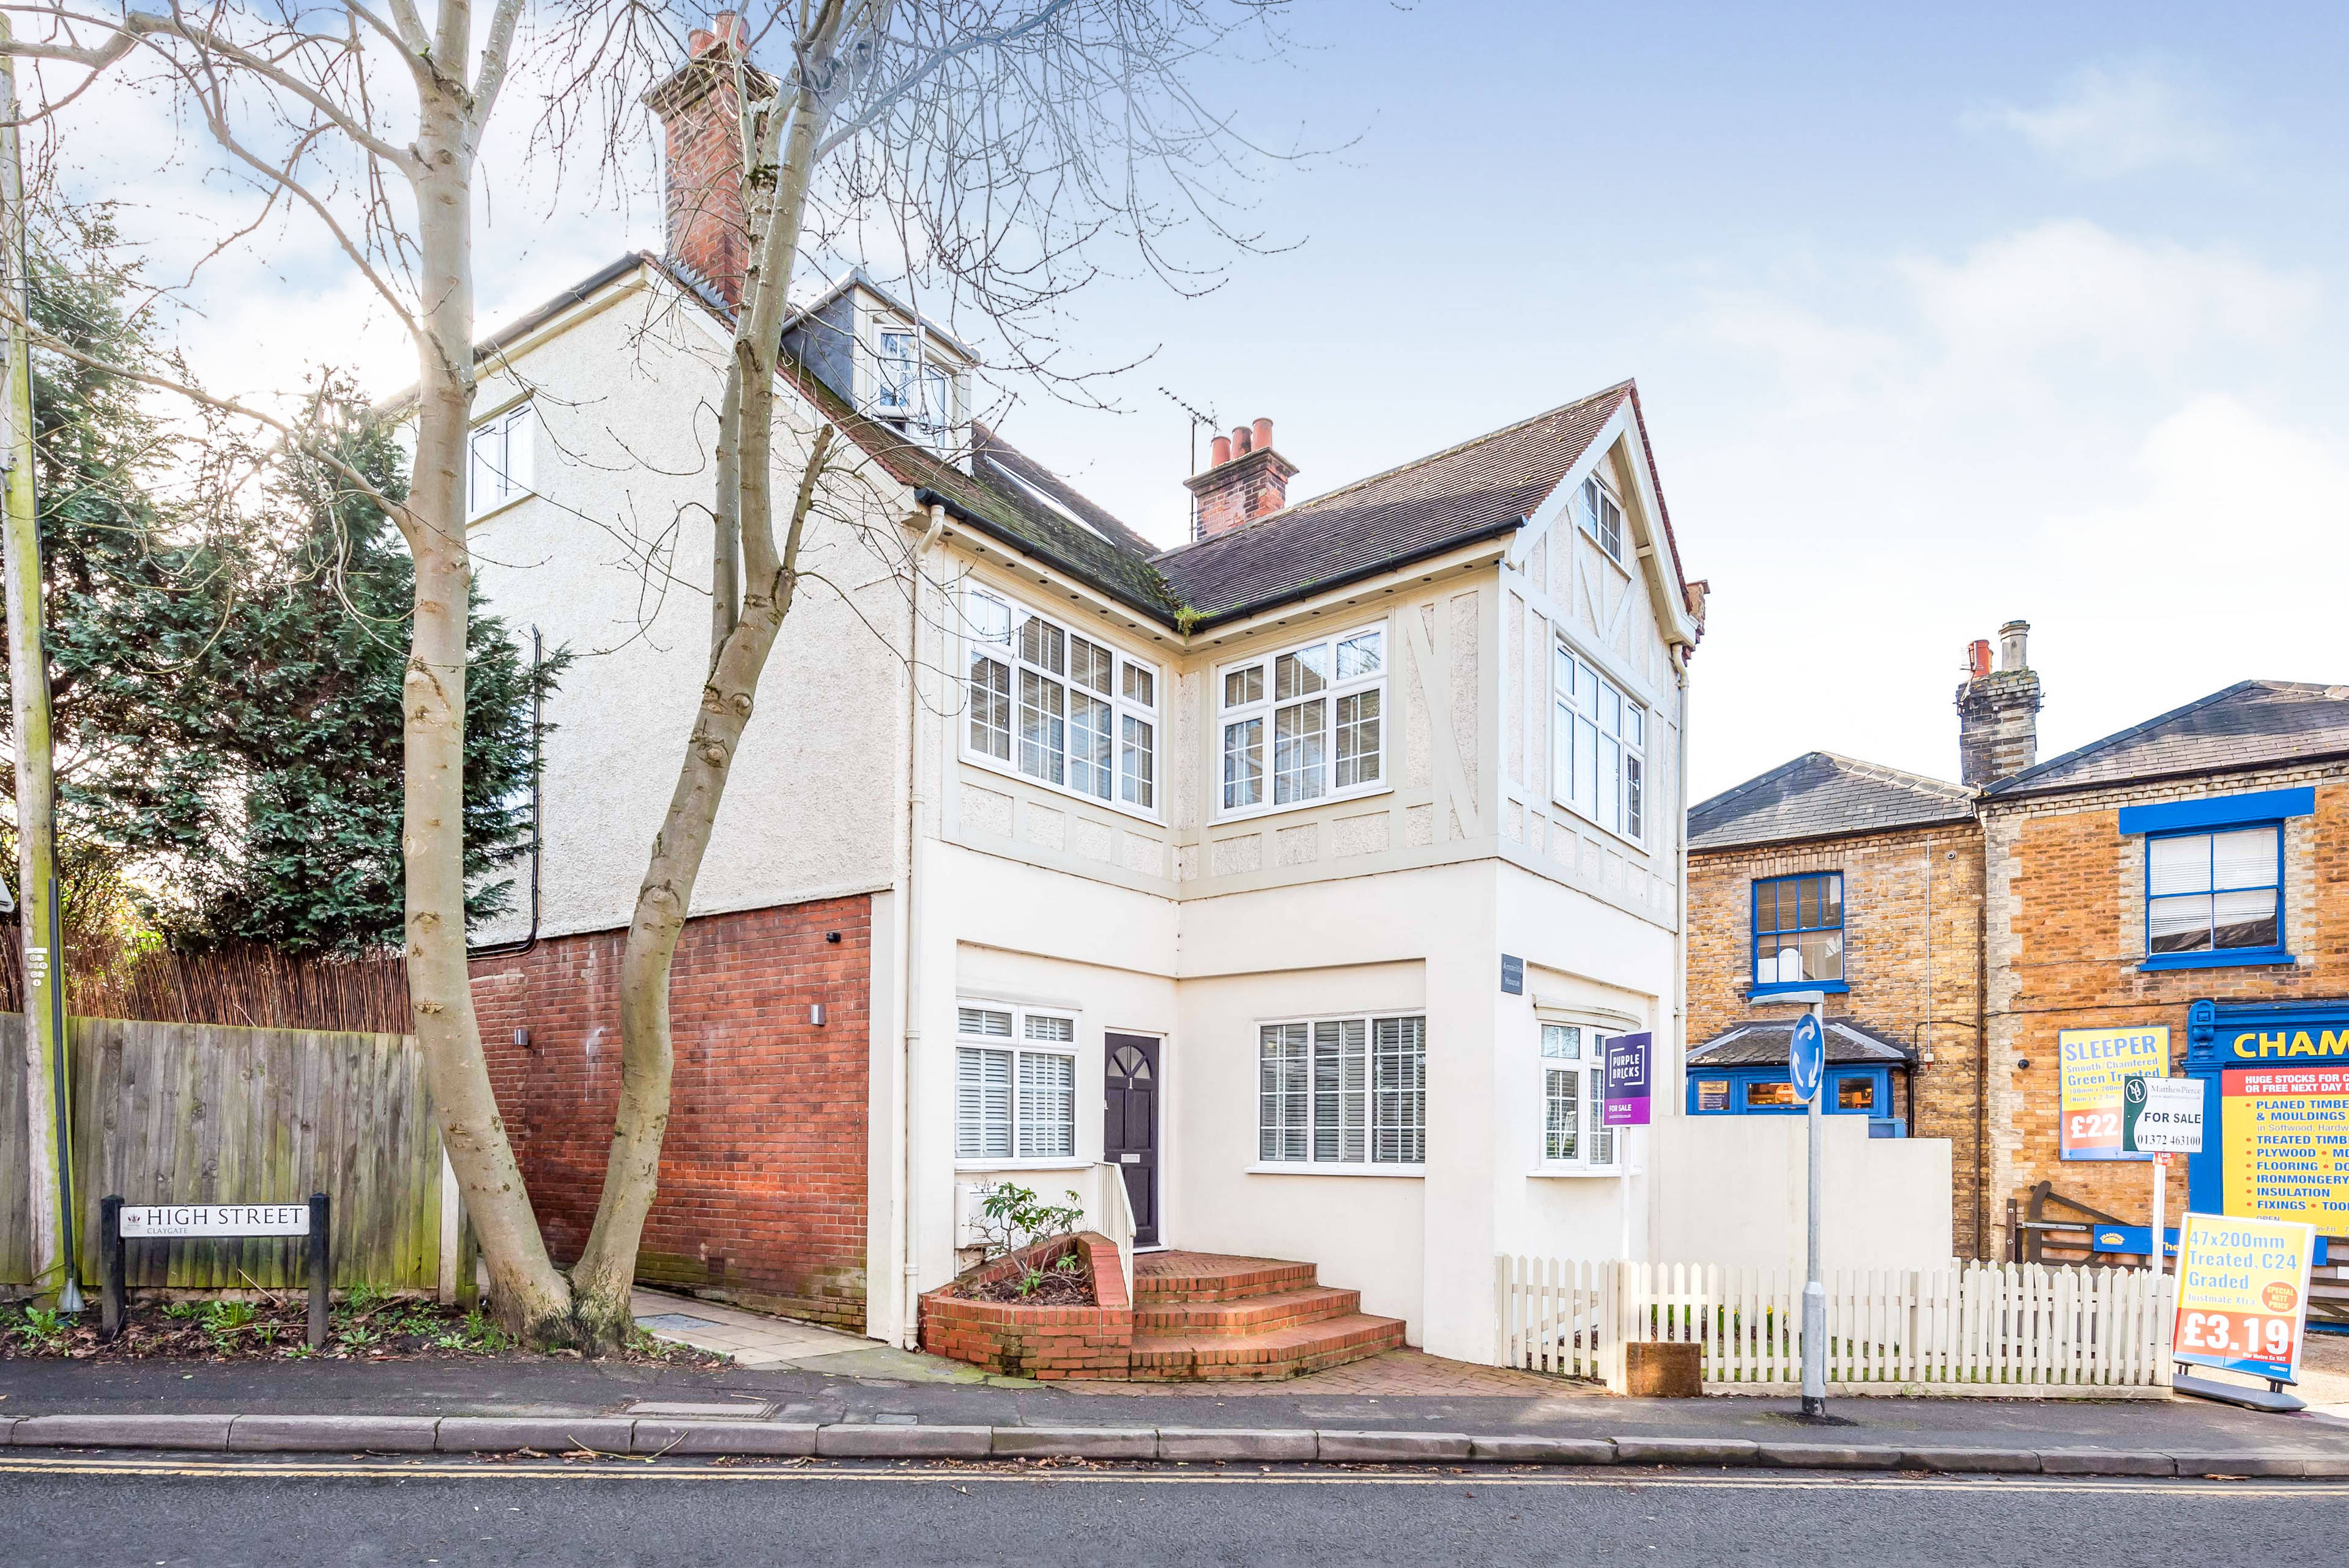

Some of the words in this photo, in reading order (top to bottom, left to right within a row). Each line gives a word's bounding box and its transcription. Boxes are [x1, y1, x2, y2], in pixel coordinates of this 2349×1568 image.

[2065, 1035, 2157, 1061] SLEEPER
[2233, 1029, 2349, 1058] CHAM
[1613, 1054, 1639, 1067] PURPLE
[1613, 1066, 1639, 1079] BRICKS
[1128, 1077, 1134, 1089] 1
[2068, 1075, 2105, 1086] Green
[2245, 1075, 2272, 1084] HUGE
[2275, 1074, 2315, 1083] STOCKS
[2318, 1074, 2339, 1082] FOR
[2245, 1084, 2260, 1093] OR
[2263, 1084, 2288, 1093] FREE
[2291, 1084, 2318, 1092] NEXT
[2321, 1083, 2342, 1092] DAY
[2256, 1101, 2305, 1109] PLANED
[2145, 1112, 2169, 1123] FOR
[2173, 1114, 2201, 1123] SALE
[2256, 1112, 2265, 1121] &
[2271, 1112, 2346, 1120] MOULDINGS
[2137, 1134, 2167, 1145] 01372
[2170, 1136, 2200, 1145] 463100
[2257, 1136, 2310, 1144] TREATED
[2315, 1136, 2349, 1144] TIMB
[2257, 1148, 2316, 1157] PLYWOOD
[2257, 1162, 2318, 1170] FLOORING
[2257, 1175, 2349, 1184] IRONMONGERY
[2257, 1188, 2330, 1197] INSULATION
[2257, 1200, 2306, 1210] FIXINGS
[147, 1209, 208, 1225] HIGH
[218, 1208, 303, 1224] STREET
[2189, 1231, 2284, 1249] 47x200mm
[2189, 1251, 2258, 1270] Treated,
[2263, 1254, 2297, 1270] C24
[2189, 1271, 2249, 1290] Graded
[2266, 1286, 2294, 1296] SPECIAL
[2269, 1301, 2289, 1310] PRICE
[2184, 1312, 2288, 1355] £3.19
